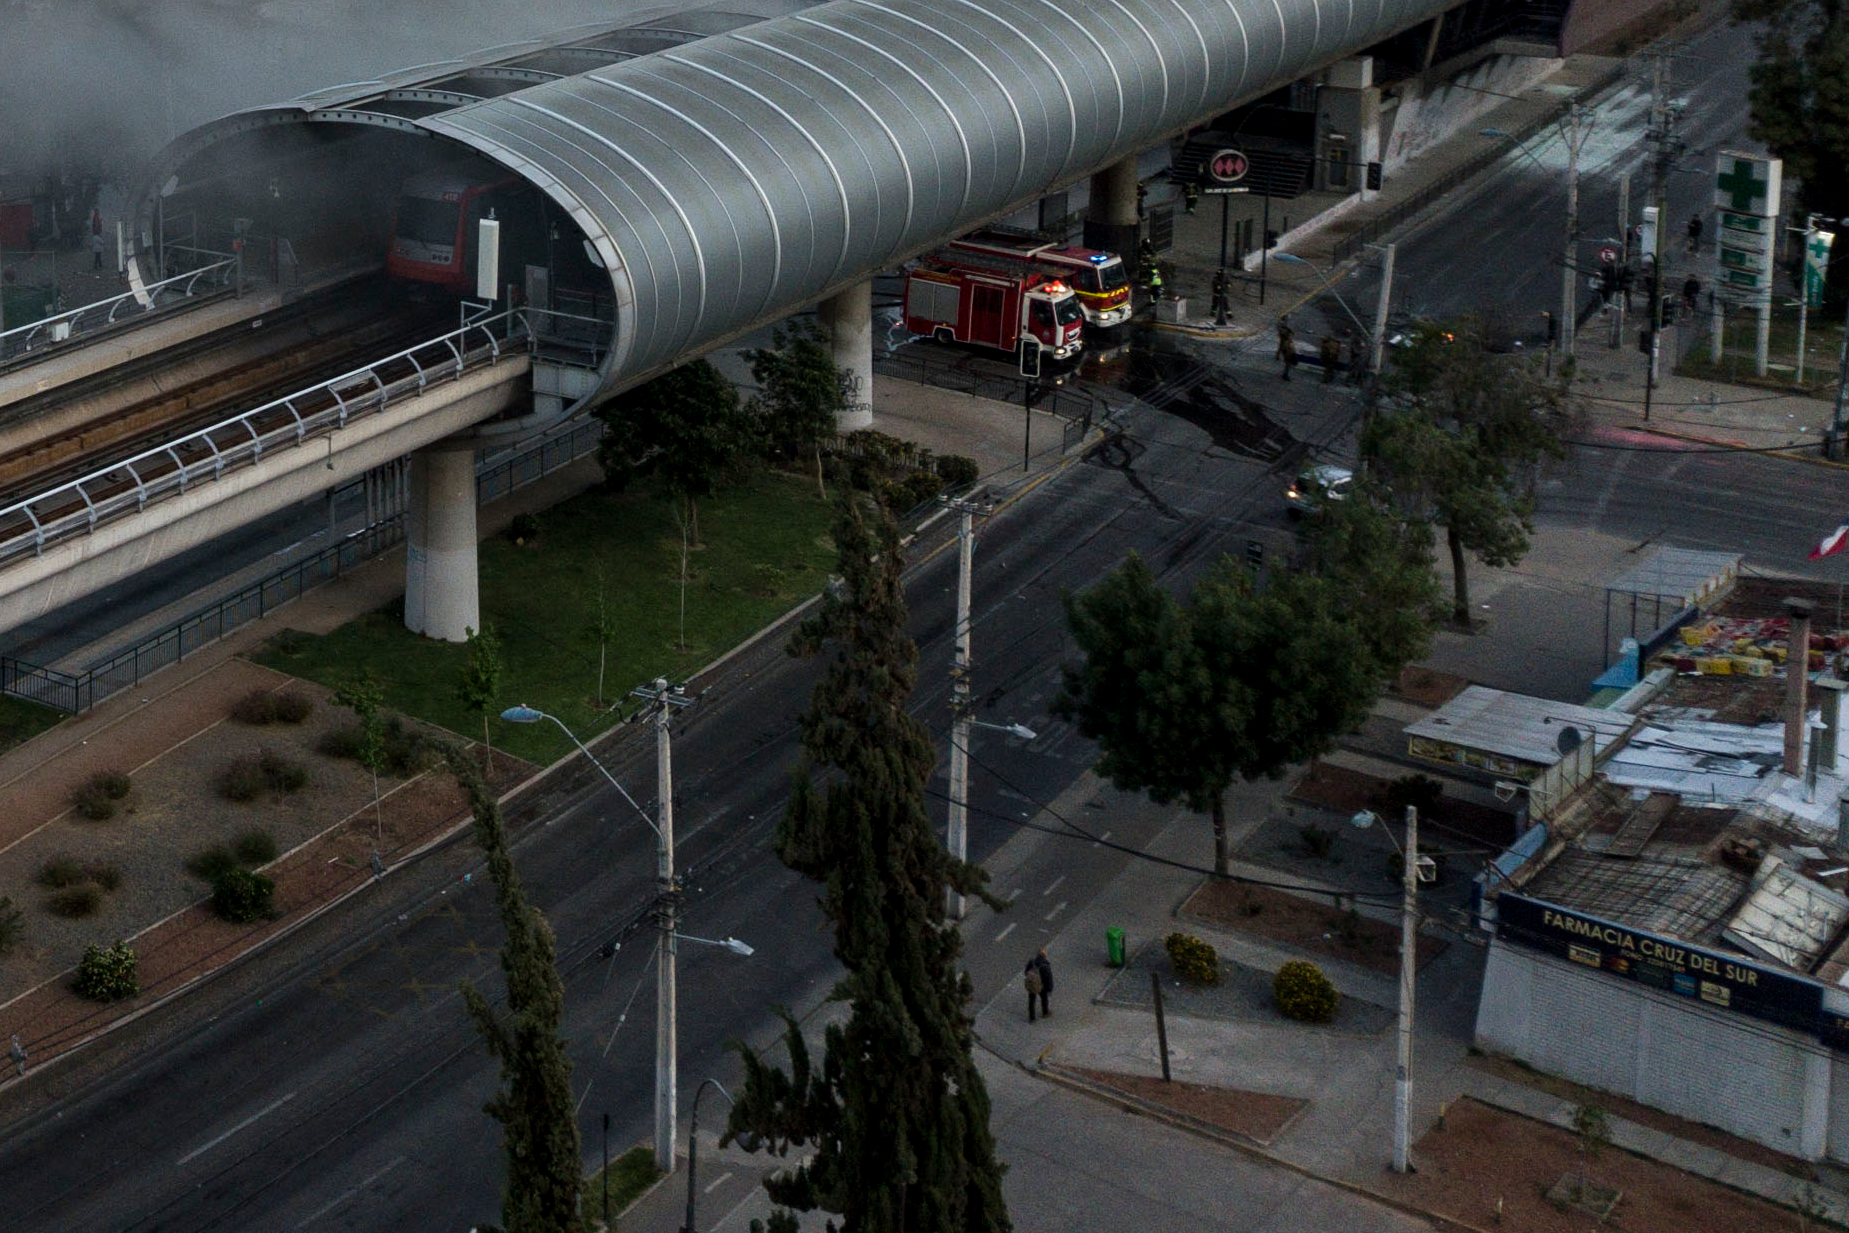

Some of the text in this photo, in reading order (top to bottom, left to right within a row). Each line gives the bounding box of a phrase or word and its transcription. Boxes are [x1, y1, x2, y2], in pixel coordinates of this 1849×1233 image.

[1543, 911, 1634, 950] FARMACIA
[1640, 939, 1685, 965] CRUZ
[1690, 955, 1721, 976] DEL
[1725, 964, 1758, 986] SUR
